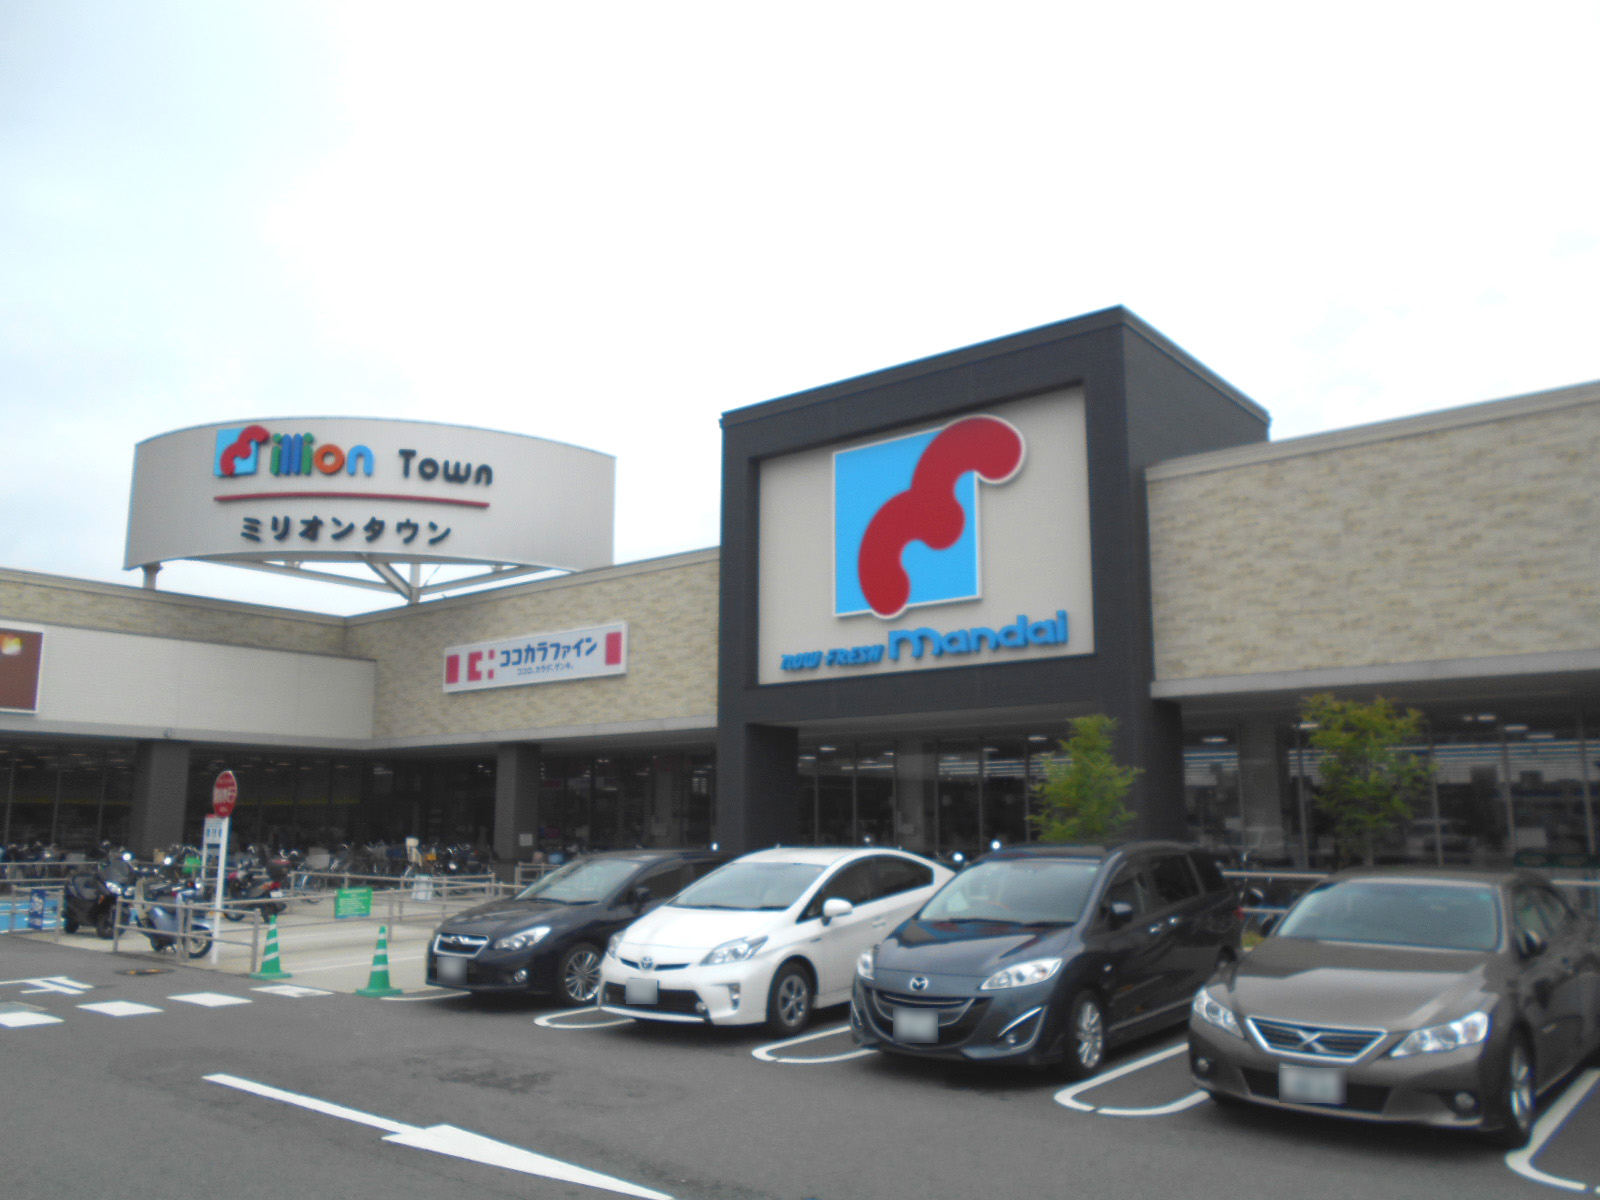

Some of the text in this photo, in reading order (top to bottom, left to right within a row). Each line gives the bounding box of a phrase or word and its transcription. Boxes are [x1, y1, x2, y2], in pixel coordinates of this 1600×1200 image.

[399, 449, 493, 485] Town
[241, 516, 451, 544] ミリオンタウン
[888, 610, 1068, 660] mandai
[500, 637, 598, 667] ココカラファイン
